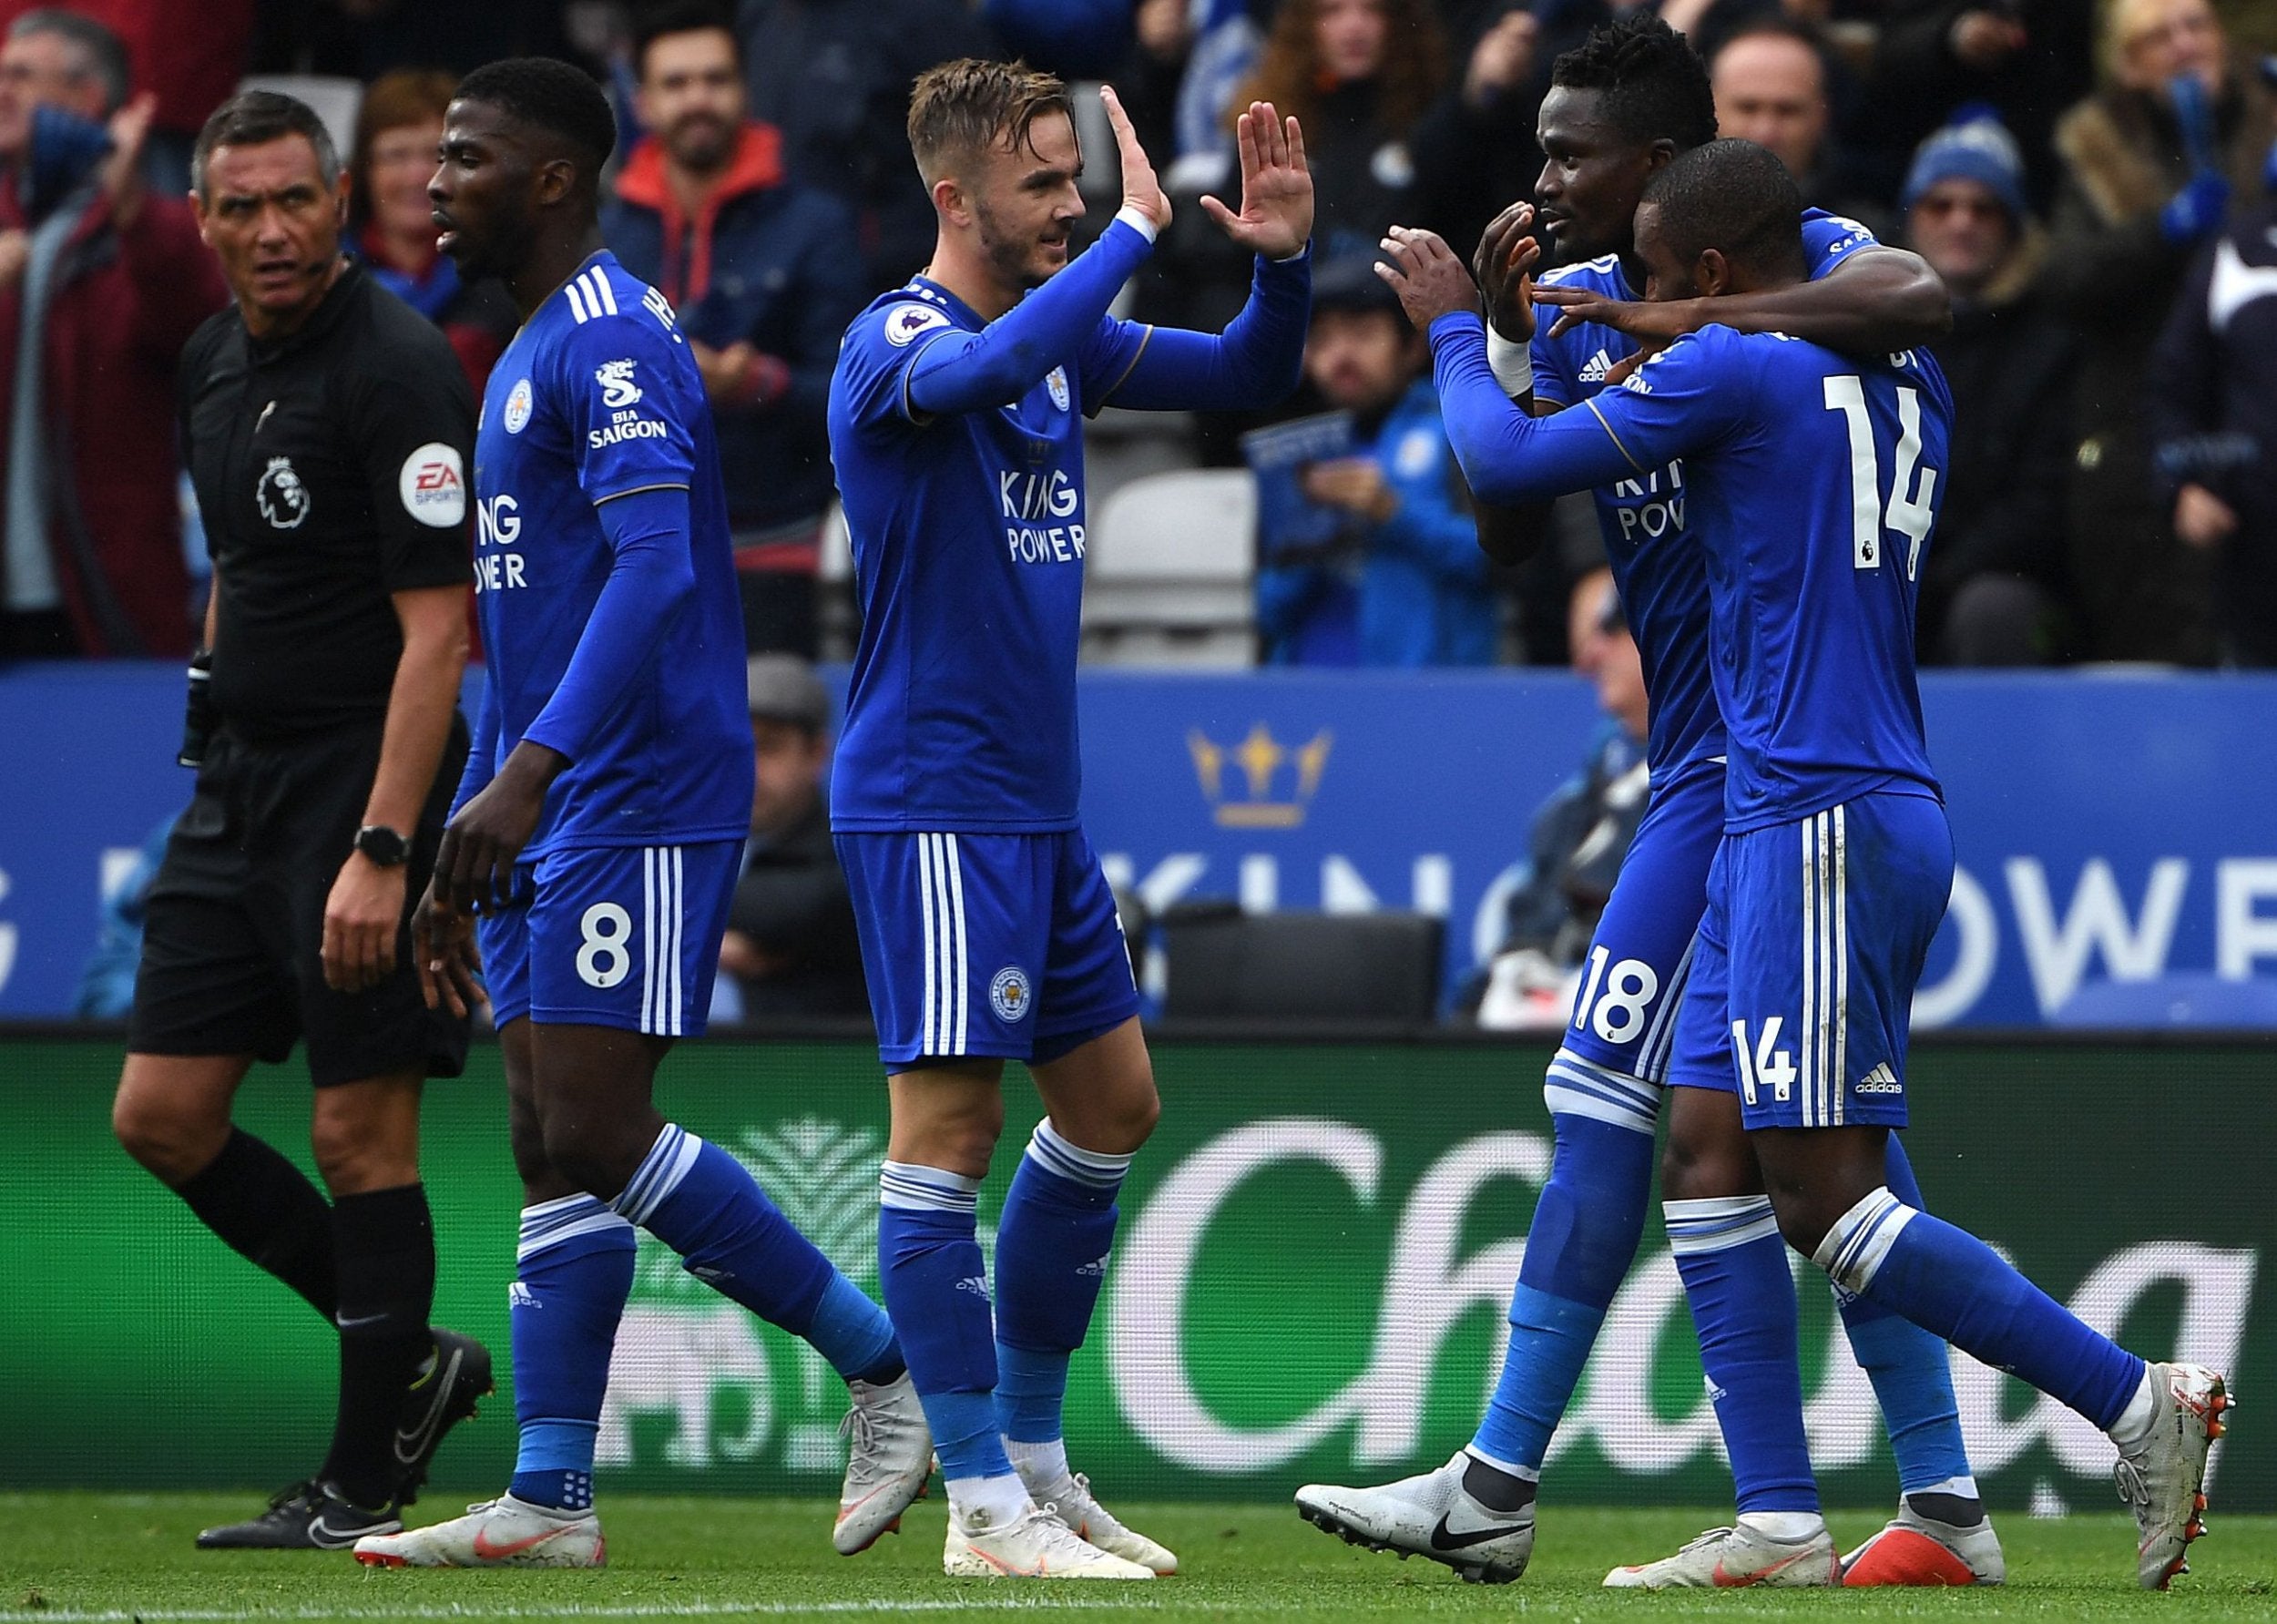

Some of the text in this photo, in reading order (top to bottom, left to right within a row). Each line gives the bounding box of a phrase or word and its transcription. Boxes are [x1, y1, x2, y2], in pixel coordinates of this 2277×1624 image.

[588, 421, 668, 449] SAIGON
[612, 409, 638, 424] BIA
[416, 462, 459, 489] EA
[1000, 469, 1078, 520] KING
[1823, 374, 1937, 582] 14
[1006, 524, 1086, 563] POWER
[576, 902, 632, 989] 8
[1575, 944, 1659, 1045] 18
[1731, 1016, 1798, 1106] 14
[1854, 1079, 1903, 1094] adidas
